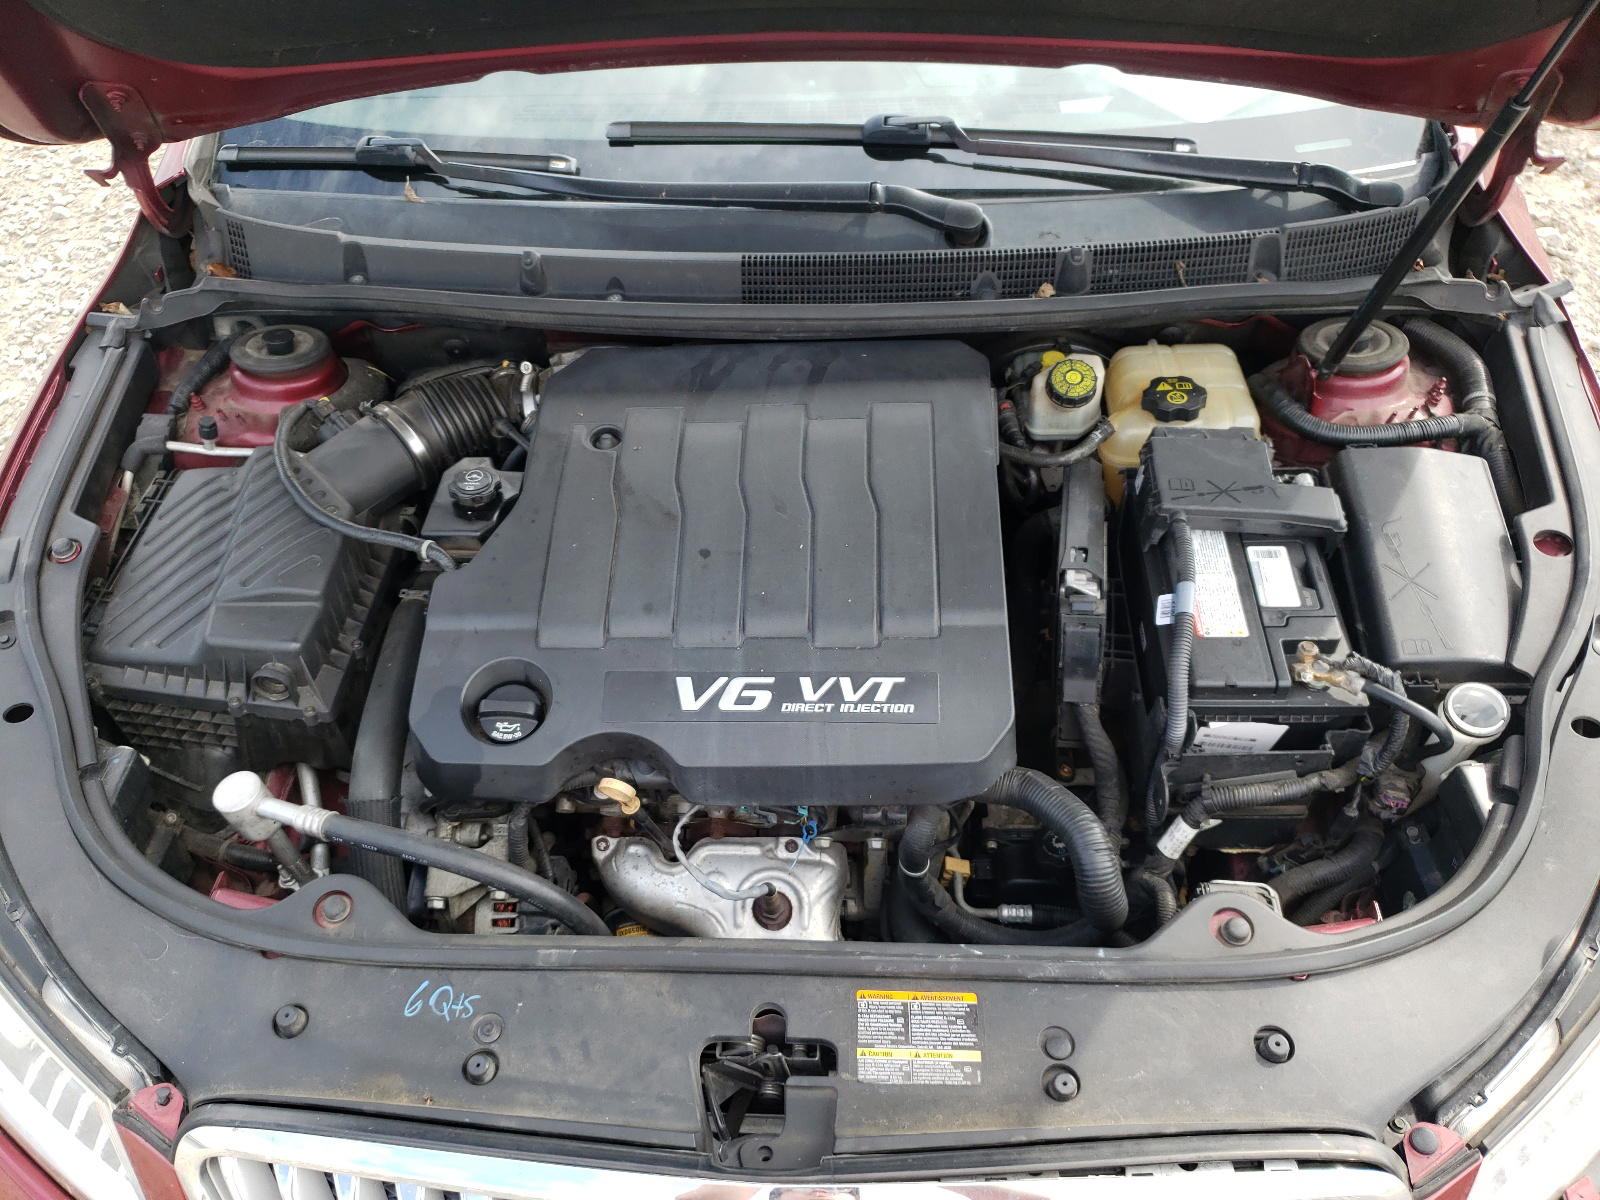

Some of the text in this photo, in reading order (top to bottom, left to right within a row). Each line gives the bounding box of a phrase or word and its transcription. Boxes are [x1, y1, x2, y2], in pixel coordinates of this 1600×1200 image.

[675, 676, 905, 712] V6 VVT
[781, 703, 914, 713] DIRECT INJECTION
[403, 980, 430, 1017] 6
